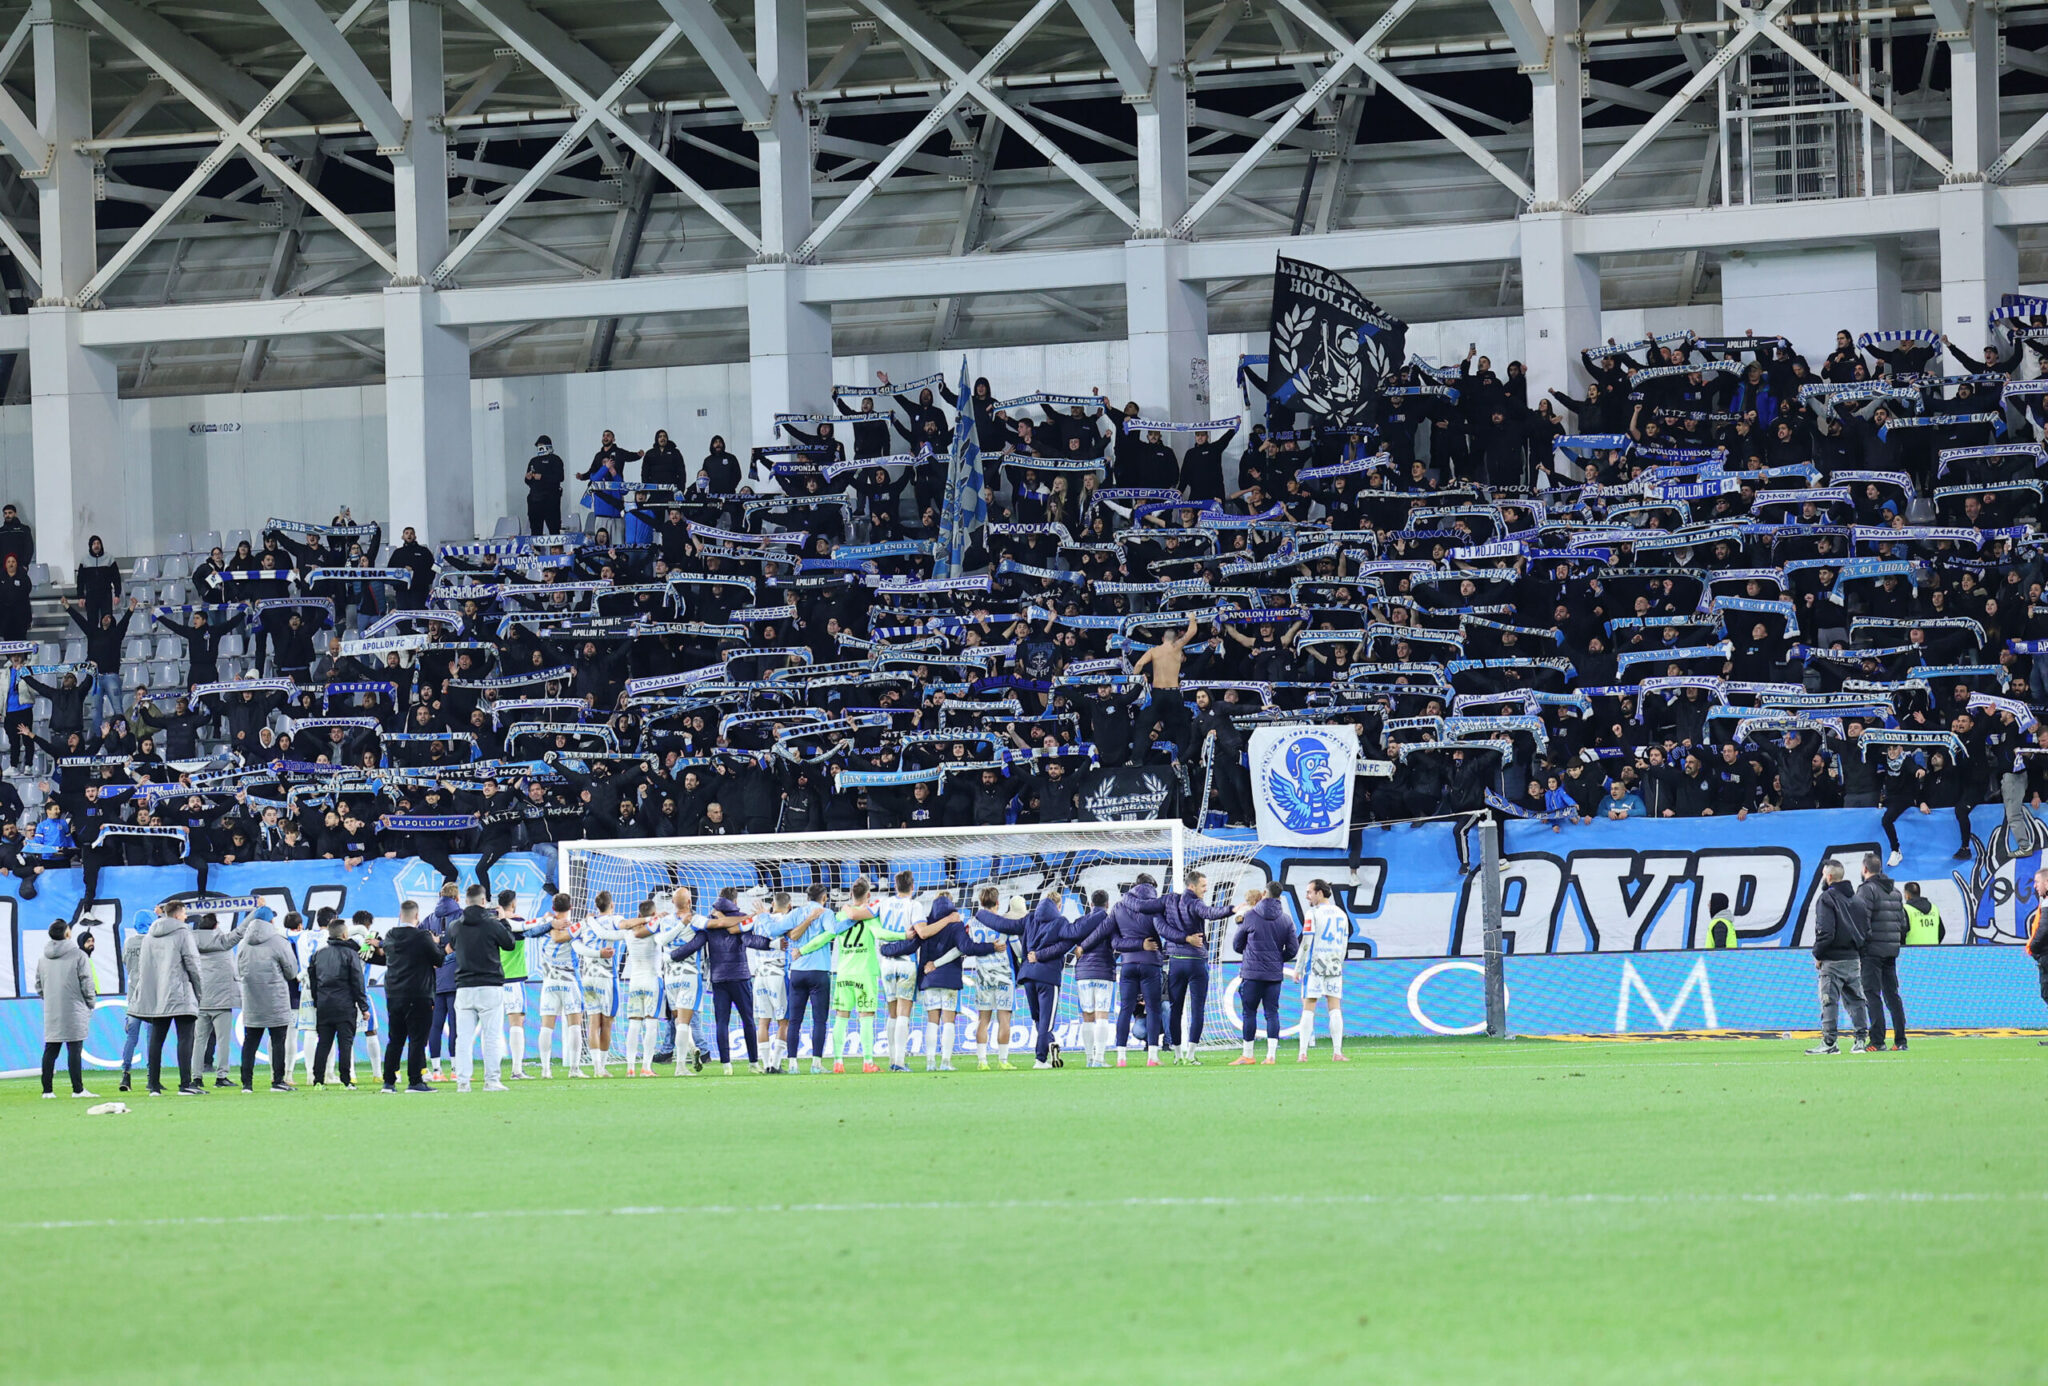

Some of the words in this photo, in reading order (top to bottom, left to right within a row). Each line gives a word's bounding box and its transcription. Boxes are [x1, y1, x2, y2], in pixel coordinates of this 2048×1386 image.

[1727, 340, 1750, 348] APOLLON
[1033, 458, 1054, 466] ONE
[1668, 482, 1705, 499] APOLLON
[1706, 482, 1717, 494] FC
[1664, 535, 1687, 544] ONE
[502, 557, 516, 566] ΜΙΑ
[531, 560, 558, 568] ΟΜΑΔΑ
[322, 570, 358, 578] ΘΥΡΑ
[796, 575, 817, 583] APOLLON
[1156, 612, 1179, 621] ONE
[1228, 610, 1264, 619] APOLLON
[1265, 608, 1299, 617] LEMESOS
[591, 619, 613, 627] APOLLON
[572, 629, 597, 637] APOLLON
[1398, 626, 1406, 634] 40
[362, 641, 395, 651] APOLLON
[396, 640, 405, 648] FC
[787, 664, 823, 674] ΘΥΡΑ
[832, 662, 860, 670] ΕΝΑ
[1382, 663, 1393, 671] 40
[634, 675, 681, 689] ΑΠΟΛΛΩΝ
[1402, 686, 1444, 695] ONE
[1762, 695, 1788, 703] GATE
[1801, 695, 1827, 704] ONE
[736, 710, 773, 720] ΘΥΡΑ
[1389, 719, 1414, 729] ΘΥΡΑ
[1416, 717, 1435, 726] ΕΝΑ
[790, 724, 829, 735] ΘΥΡΑ
[1885, 733, 1908, 741] ONE
[1369, 764, 1380, 772] FC
[398, 818, 445, 827] APOLLON
[109, 826, 145, 834] ΘΥΡΑ
[883, 909, 905, 933] 44
[1920, 918, 1935, 928] 104
[1322, 912, 1346, 945] 45
[844, 920, 865, 948] 22
